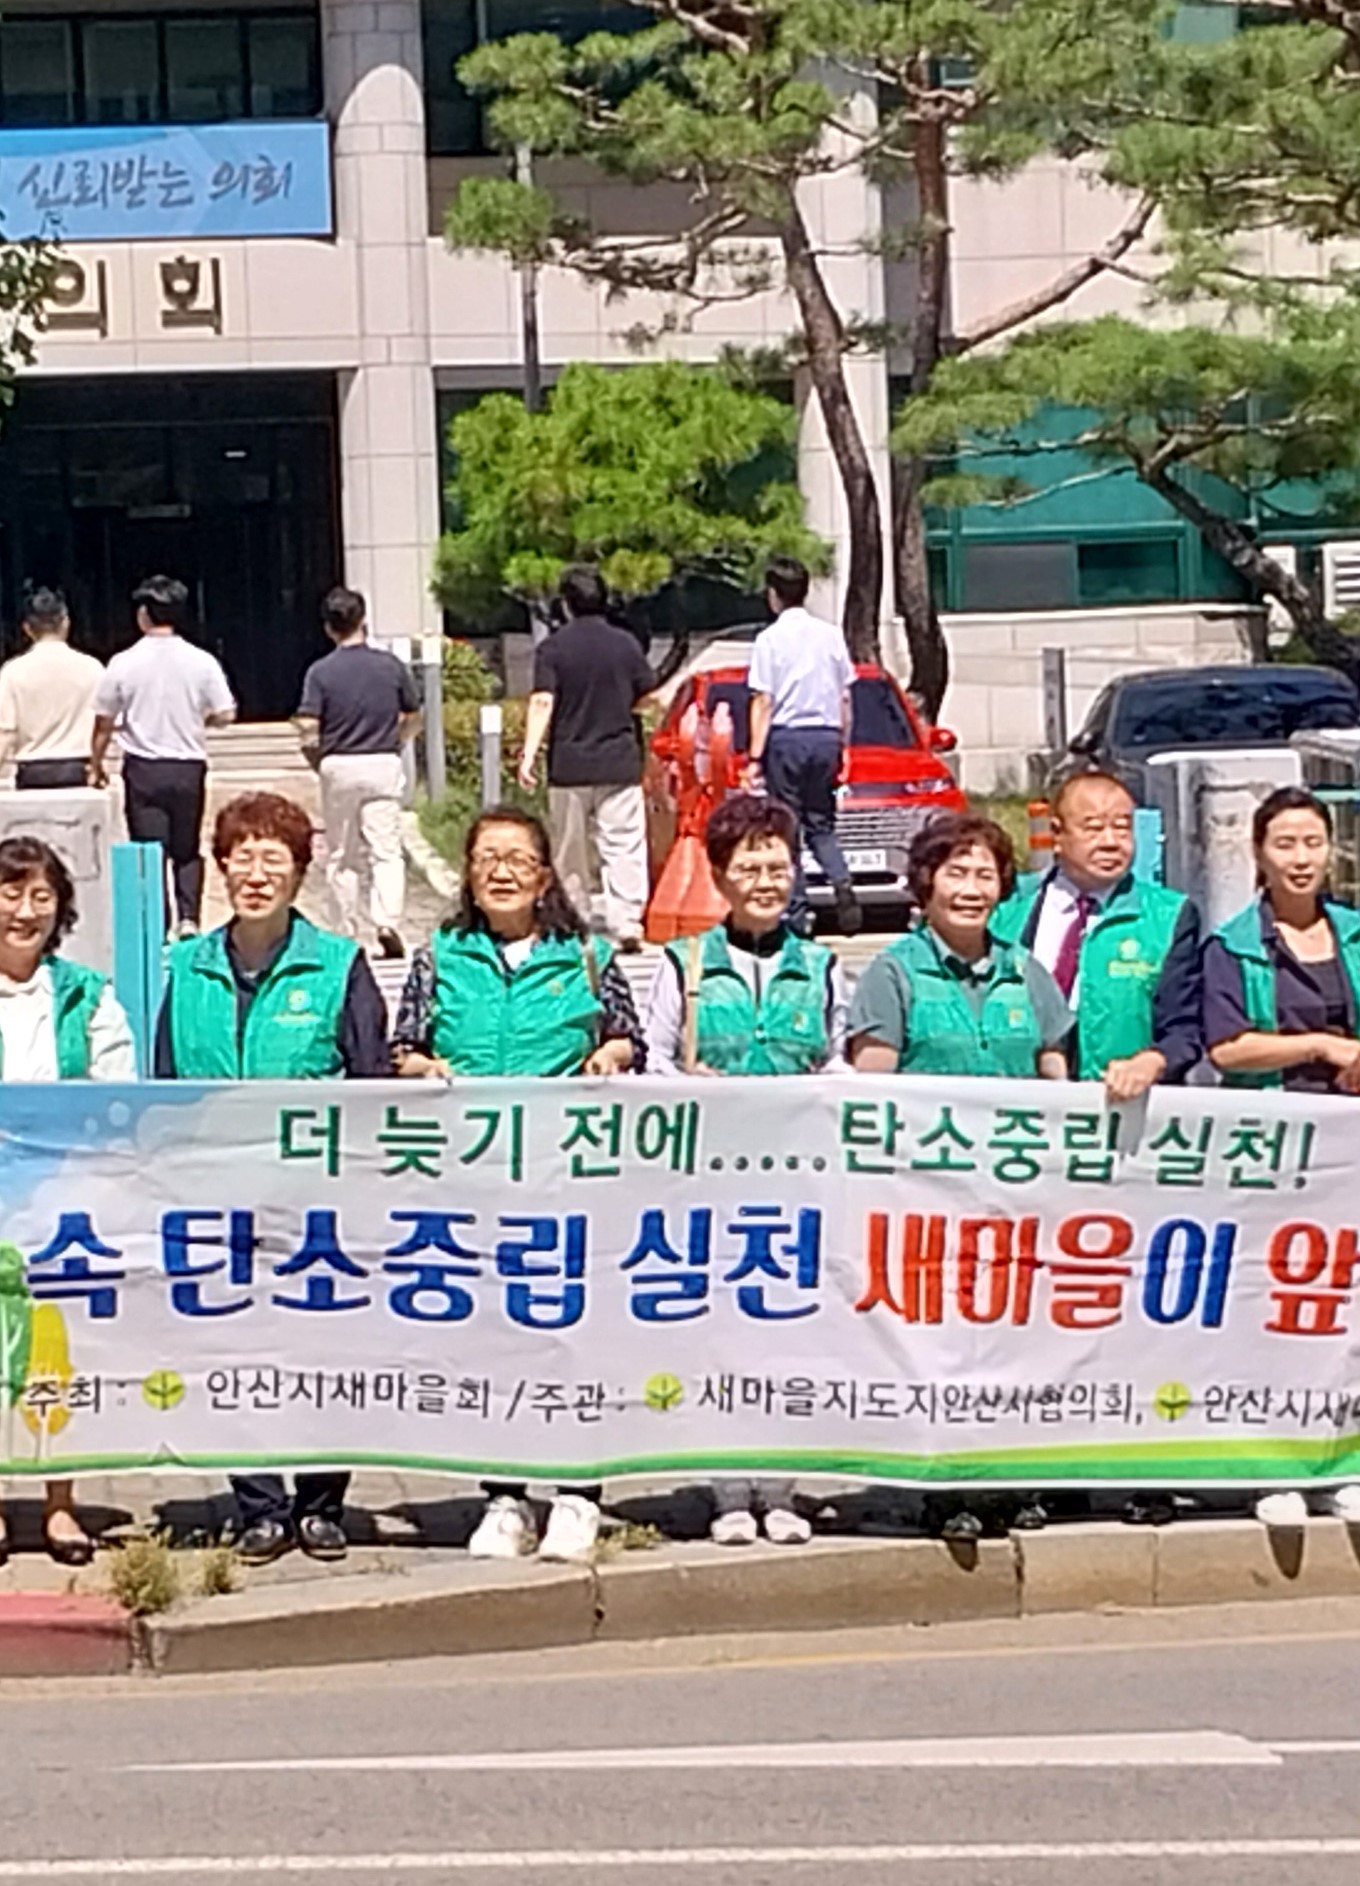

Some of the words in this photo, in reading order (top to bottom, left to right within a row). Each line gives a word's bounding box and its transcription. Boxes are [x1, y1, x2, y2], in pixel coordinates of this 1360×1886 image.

[18, 153, 194, 210] 신뢰받는
[208, 153, 293, 206] 의회
[279, 1105, 340, 1177] 더
[377, 1103, 524, 1181] 늦기
[840, 1099, 1123, 1185] 탄소중립
[1148, 1115, 1317, 1190] 실천!
[27, 1212, 127, 1320] 속
[160, 1208, 588, 1330] 탄소중립
[619, 1205, 822, 1322] 실천
[854, 1211, 1237, 1330] 새마을이
[206, 1368, 490, 1418] 안산시새마을회
